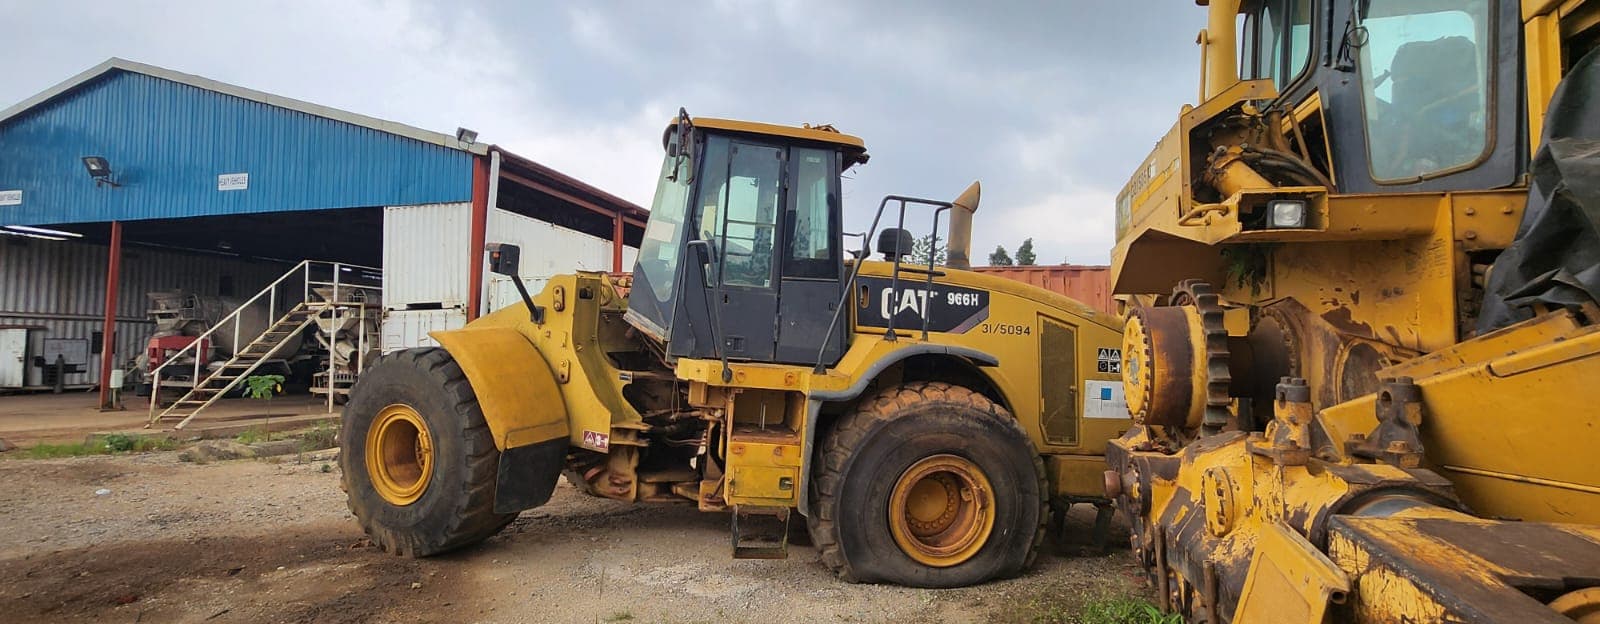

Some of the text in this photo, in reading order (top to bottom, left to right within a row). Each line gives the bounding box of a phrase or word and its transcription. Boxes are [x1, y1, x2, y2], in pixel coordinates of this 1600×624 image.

[881, 287, 979, 319] CAT 966H
[982, 323, 1030, 336] 31/5094
